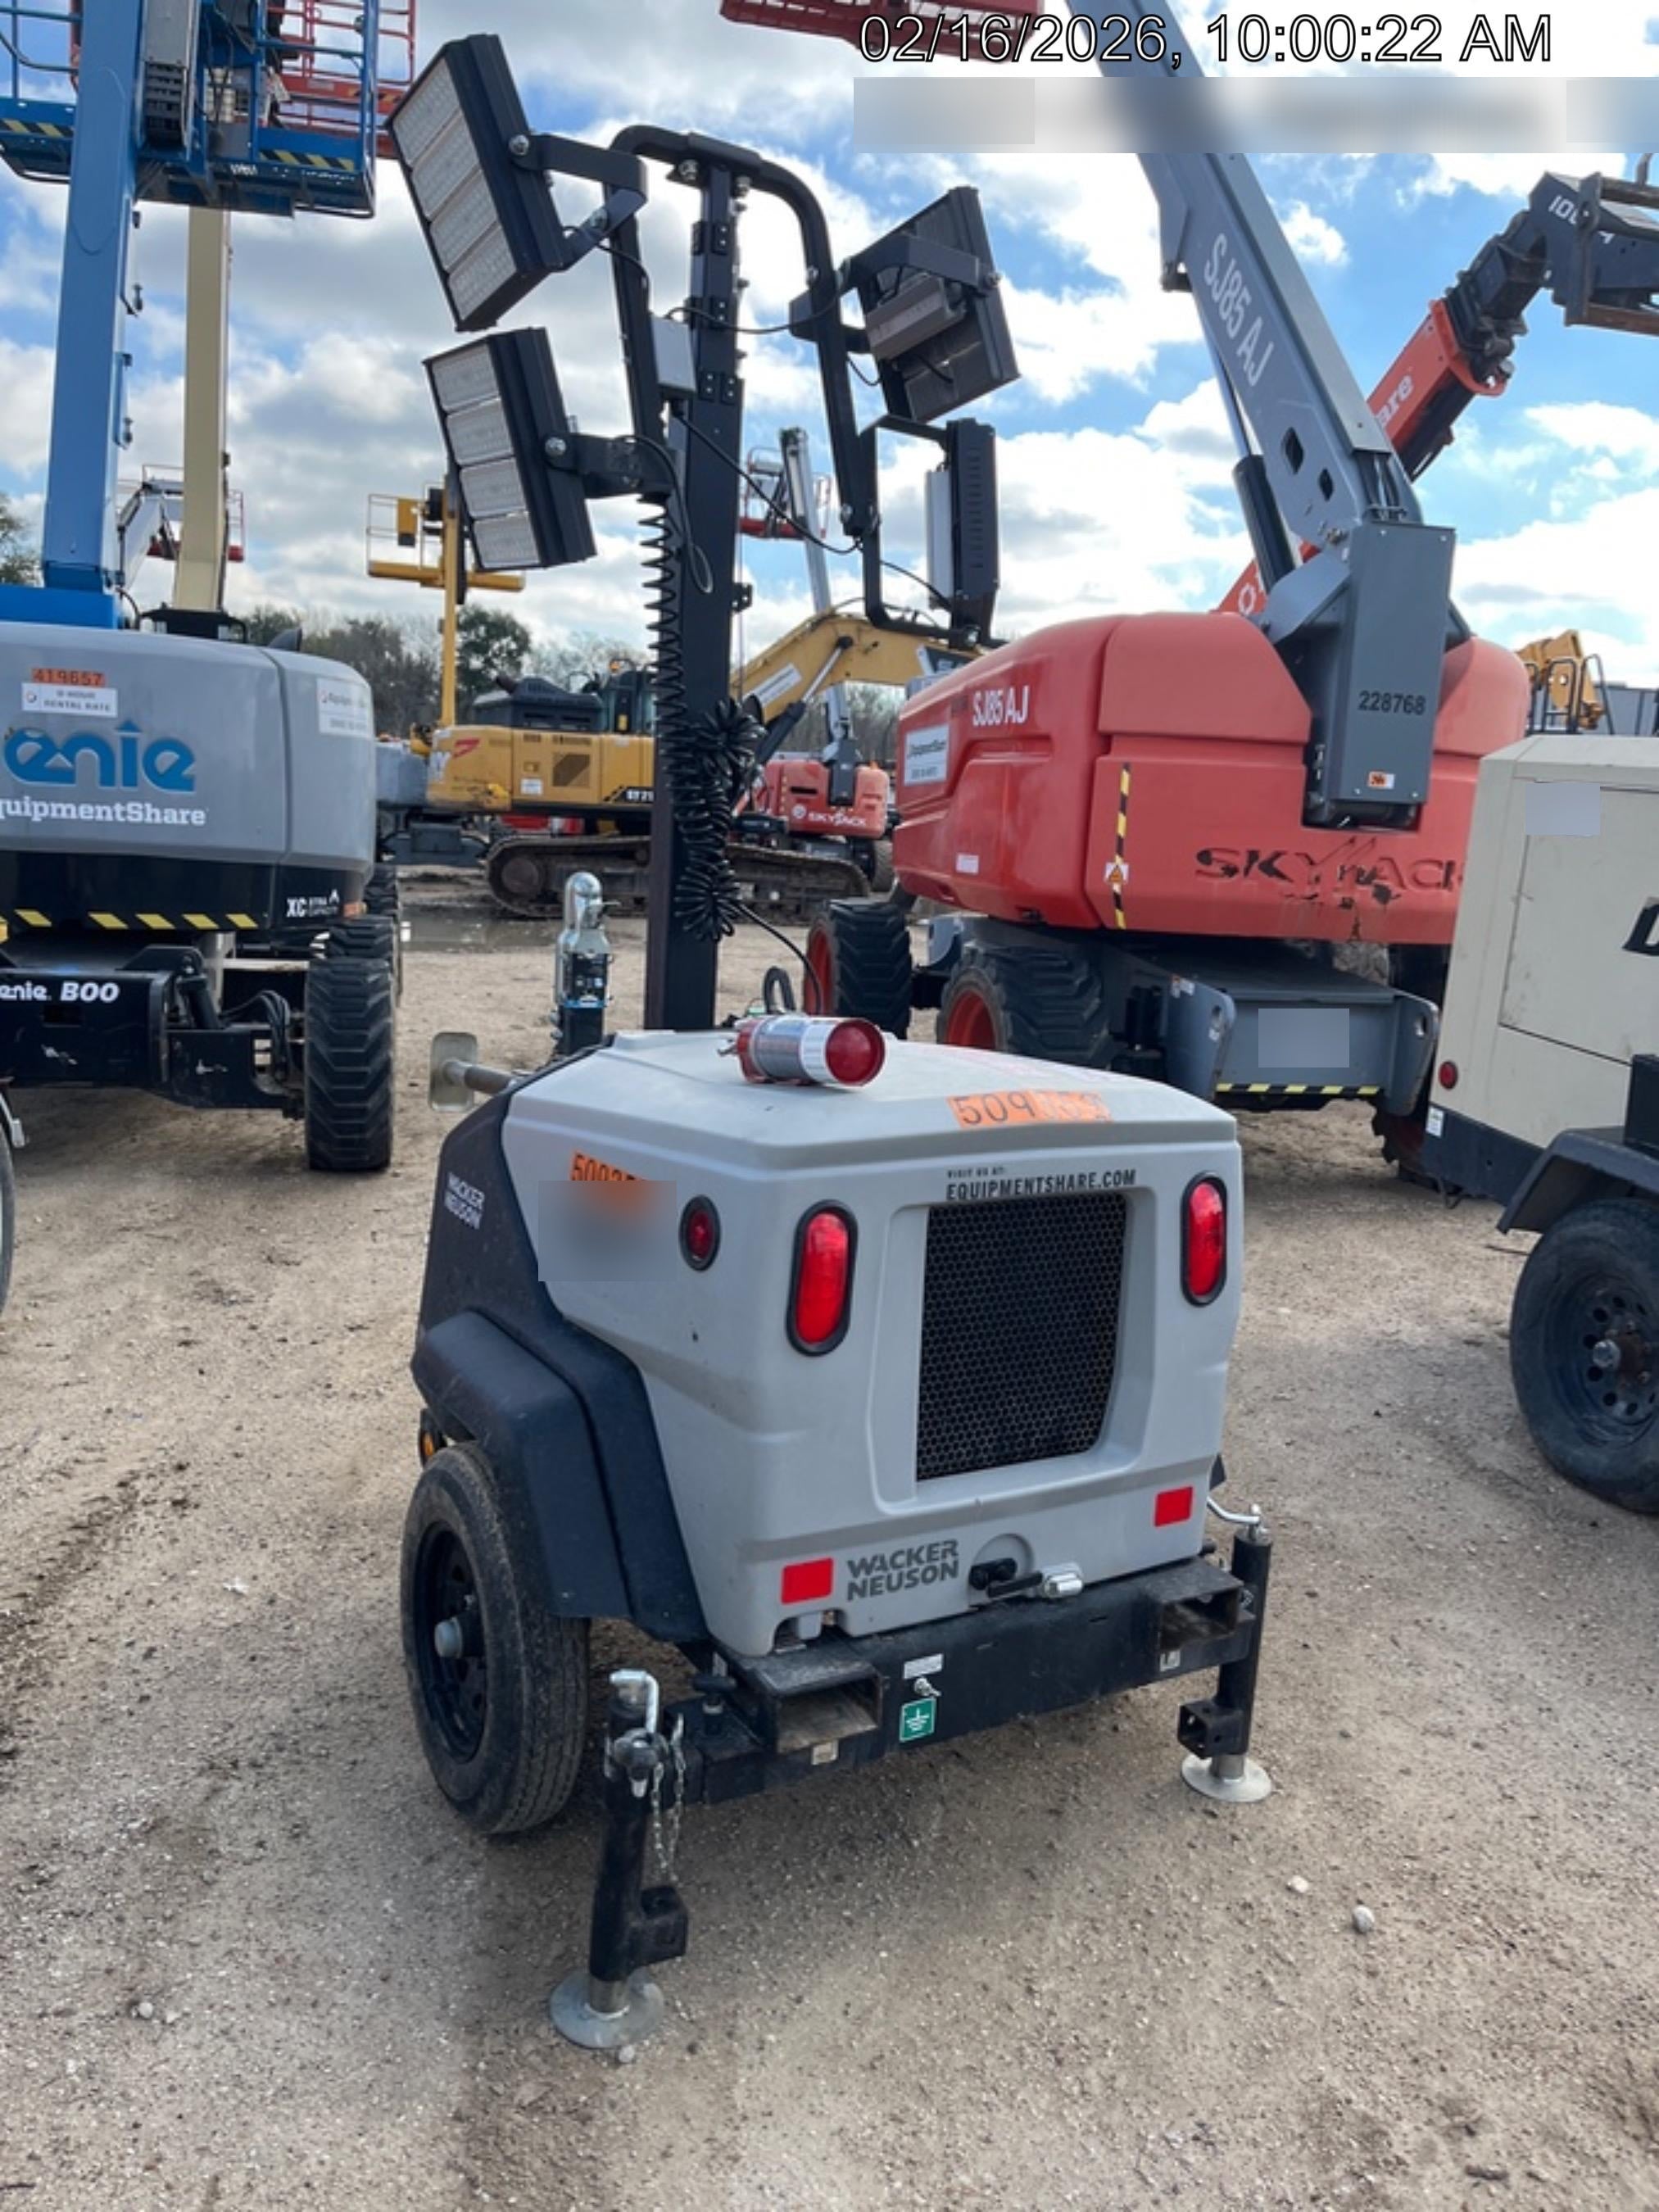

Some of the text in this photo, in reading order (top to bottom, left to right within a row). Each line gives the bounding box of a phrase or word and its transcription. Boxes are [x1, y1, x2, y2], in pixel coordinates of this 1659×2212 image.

[1204, 233, 1274, 387] SJ85 AJ
[1004, 685, 1029, 723] AJ
[1358, 690, 1426, 716] 228768
[2, 720, 197, 794] enie
[0, 981, 48, 1001] enie
[946, 1168, 1137, 1201] EQUIPMENTSHARE.COM
[847, 1539, 959, 1579] WACKER
[847, 1559, 959, 1602] NEUSON
